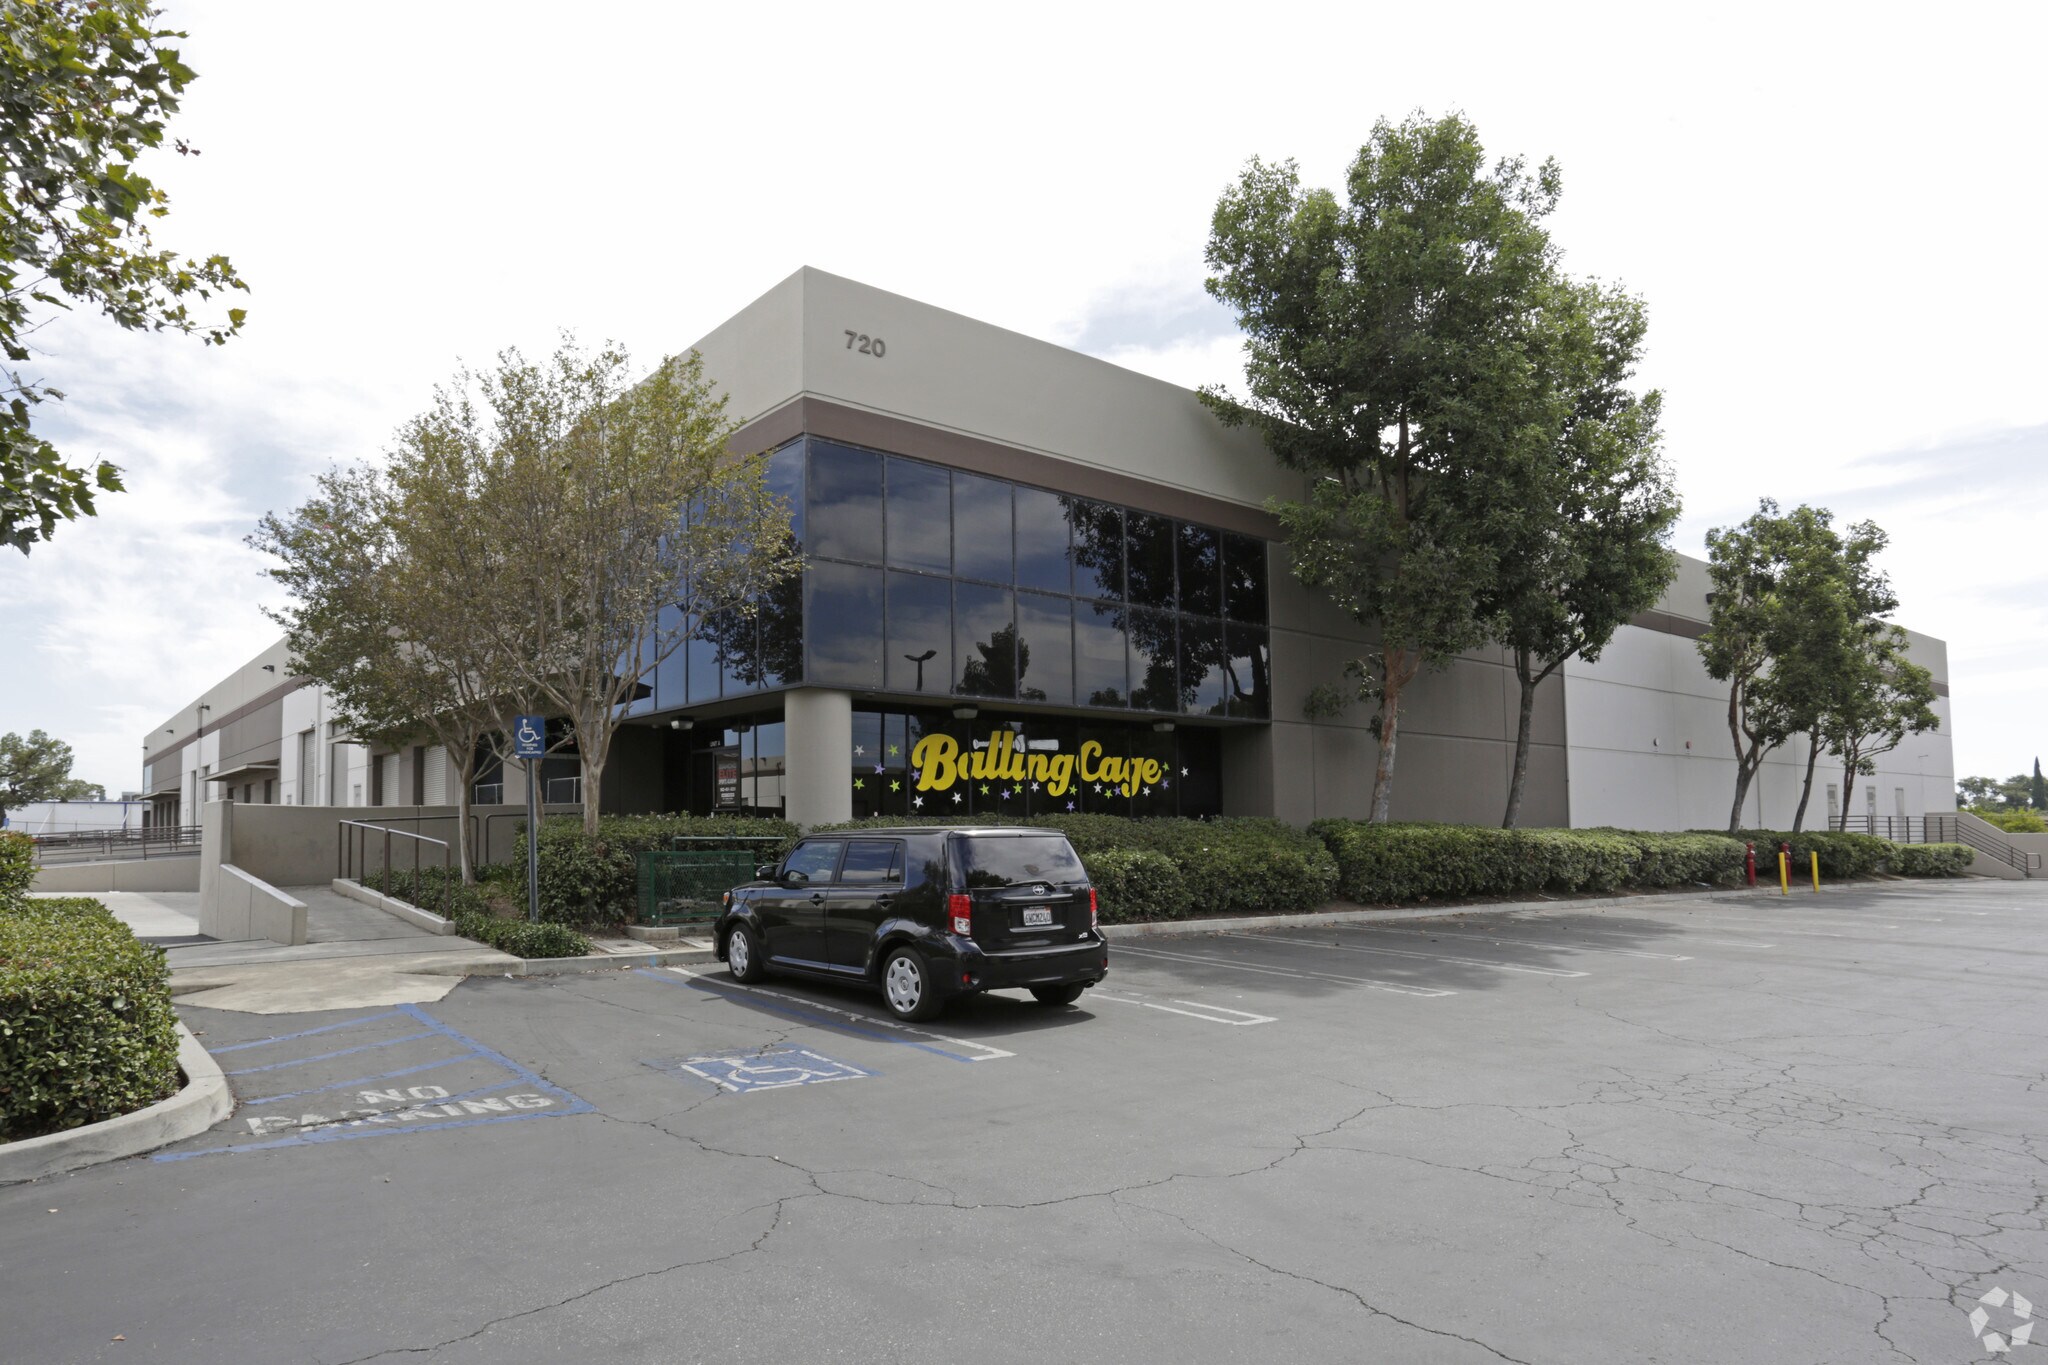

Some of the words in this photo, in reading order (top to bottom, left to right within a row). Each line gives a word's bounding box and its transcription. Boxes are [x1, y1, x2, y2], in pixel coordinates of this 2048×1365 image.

[844, 329, 886, 358] 720
[911, 730, 1074, 797] Batting
[1077, 740, 1162, 798] Cage
[356, 1085, 450, 1105] NO
[246, 1093, 554, 1136] PARKING
